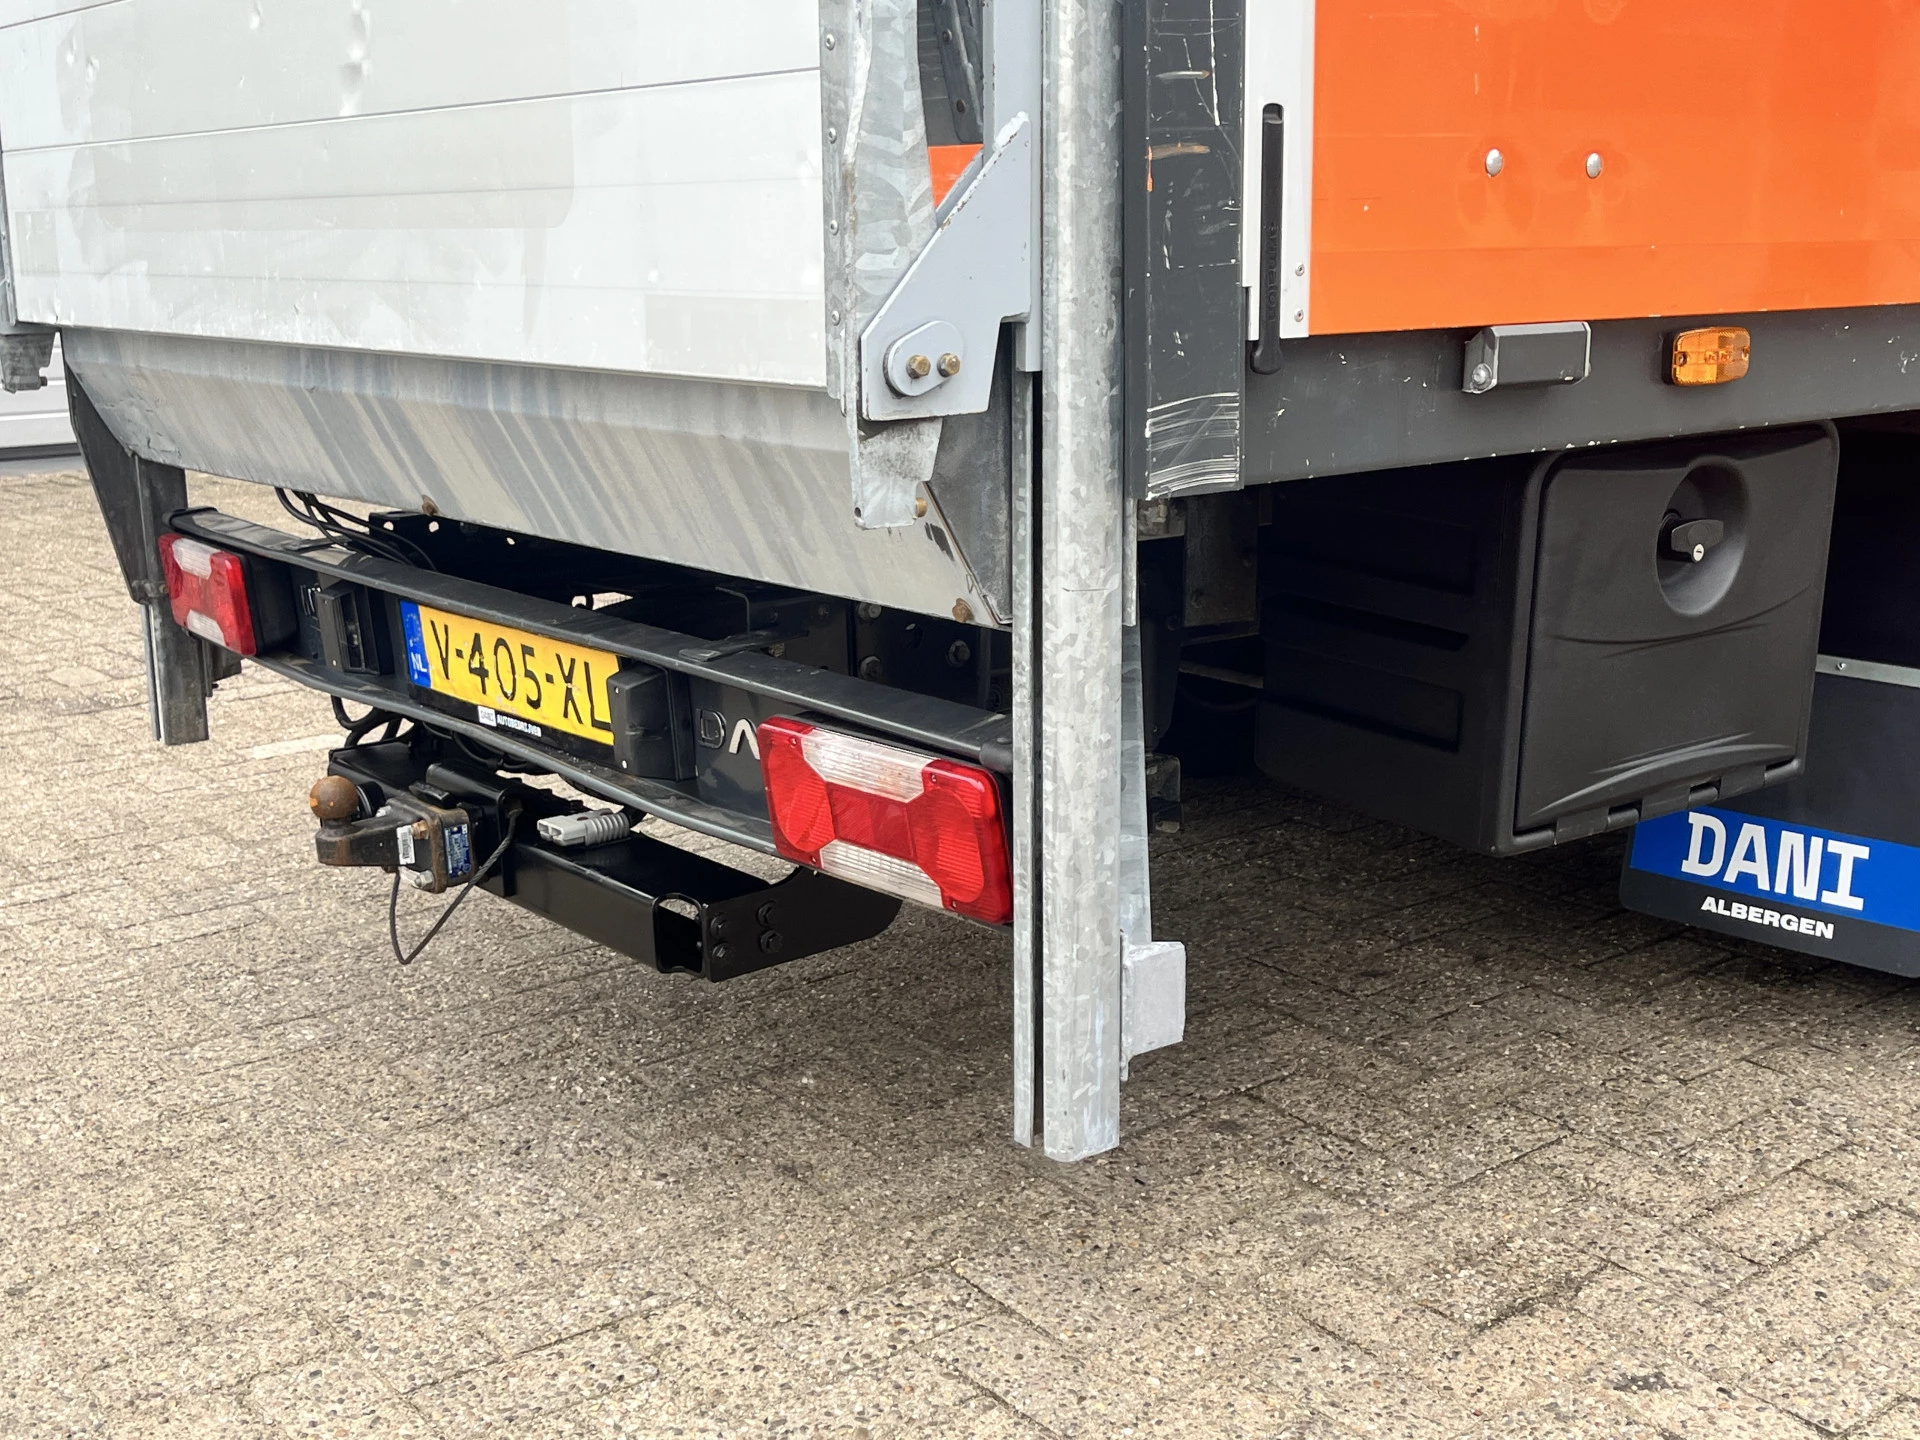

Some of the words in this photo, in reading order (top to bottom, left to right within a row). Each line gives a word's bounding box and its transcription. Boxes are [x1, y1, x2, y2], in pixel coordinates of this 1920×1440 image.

[410, 651, 428, 673] NL
[429, 619, 612, 732] V-405-XL
[696, 708, 761, 760] DA
[1681, 811, 1870, 911] DANI
[1701, 896, 1835, 940] ALBERGEN
